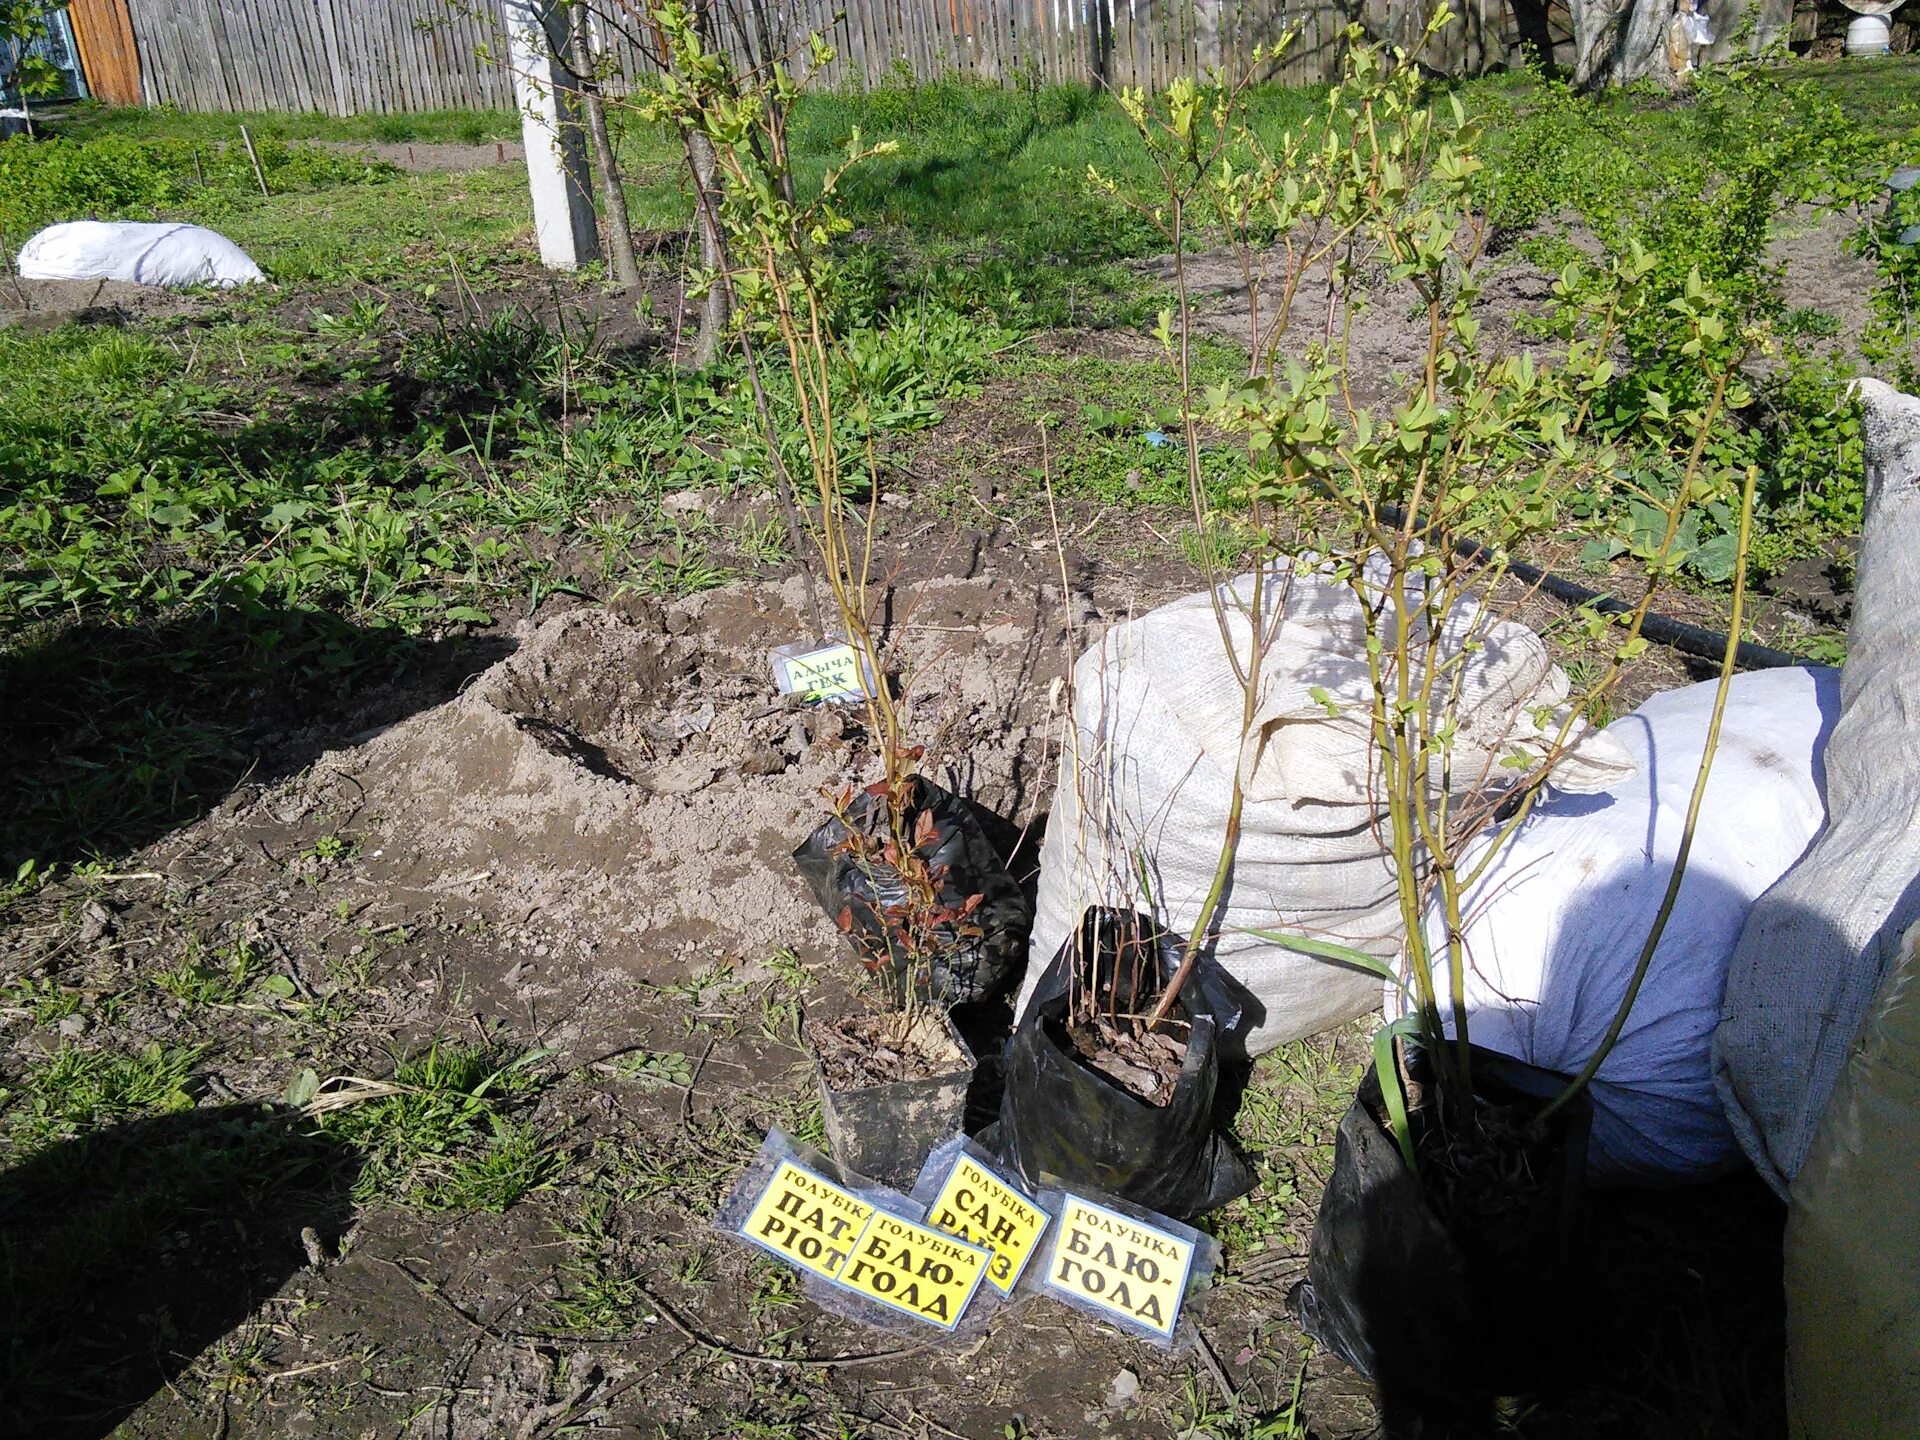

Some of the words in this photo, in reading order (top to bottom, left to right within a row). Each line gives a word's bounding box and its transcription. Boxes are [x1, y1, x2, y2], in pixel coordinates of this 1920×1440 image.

[794, 656, 853, 680] АЛЫЧА
[807, 672, 847, 691] ГЕК
[776, 1190, 857, 1243] ПАТ-
[955, 1189, 1021, 1247] САН-
[962, 1165, 1035, 1228] ГОЛУБІКА
[760, 1214, 846, 1272] РІОТ
[878, 1218, 976, 1267] ГОЛУБІКА
[1067, 1228, 1173, 1286] БЛЮ-
[1074, 1207, 1180, 1260] ГОЛУБІКА
[863, 1236, 965, 1287] БЛЮ-
[848, 1259, 949, 1321] ГОЛД
[1057, 1257, 1164, 1326] ГОЛД
